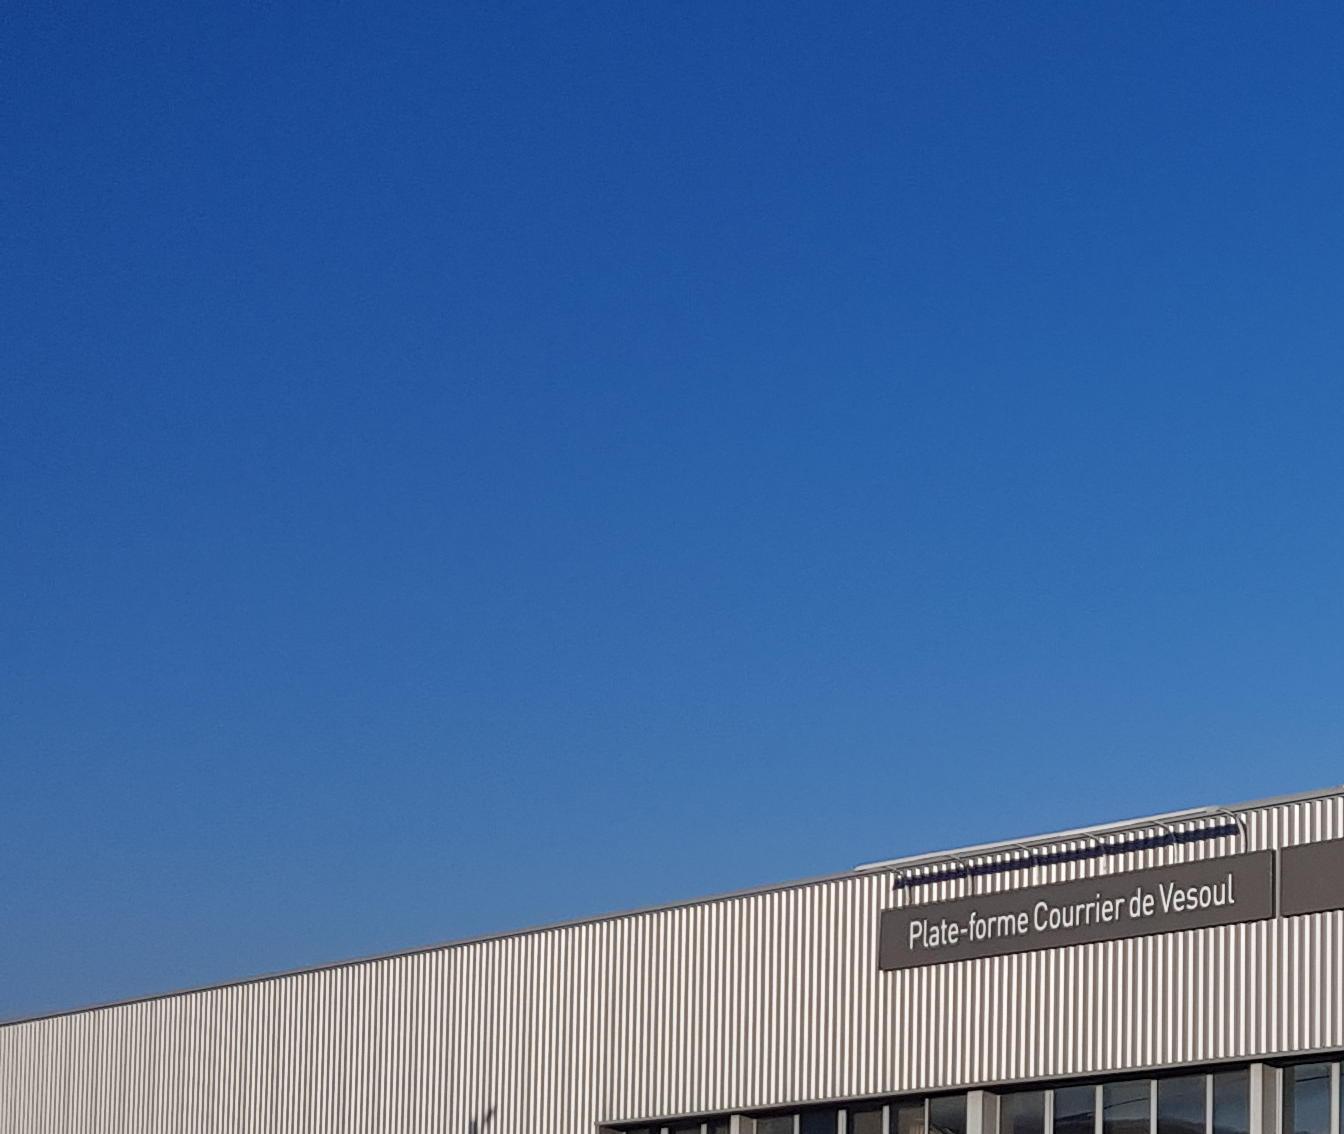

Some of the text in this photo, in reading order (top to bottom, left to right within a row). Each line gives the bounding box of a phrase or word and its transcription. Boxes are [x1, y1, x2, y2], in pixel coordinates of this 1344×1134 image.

[909, 873, 1235, 950] Plate-forme Courrier de Vesoul
